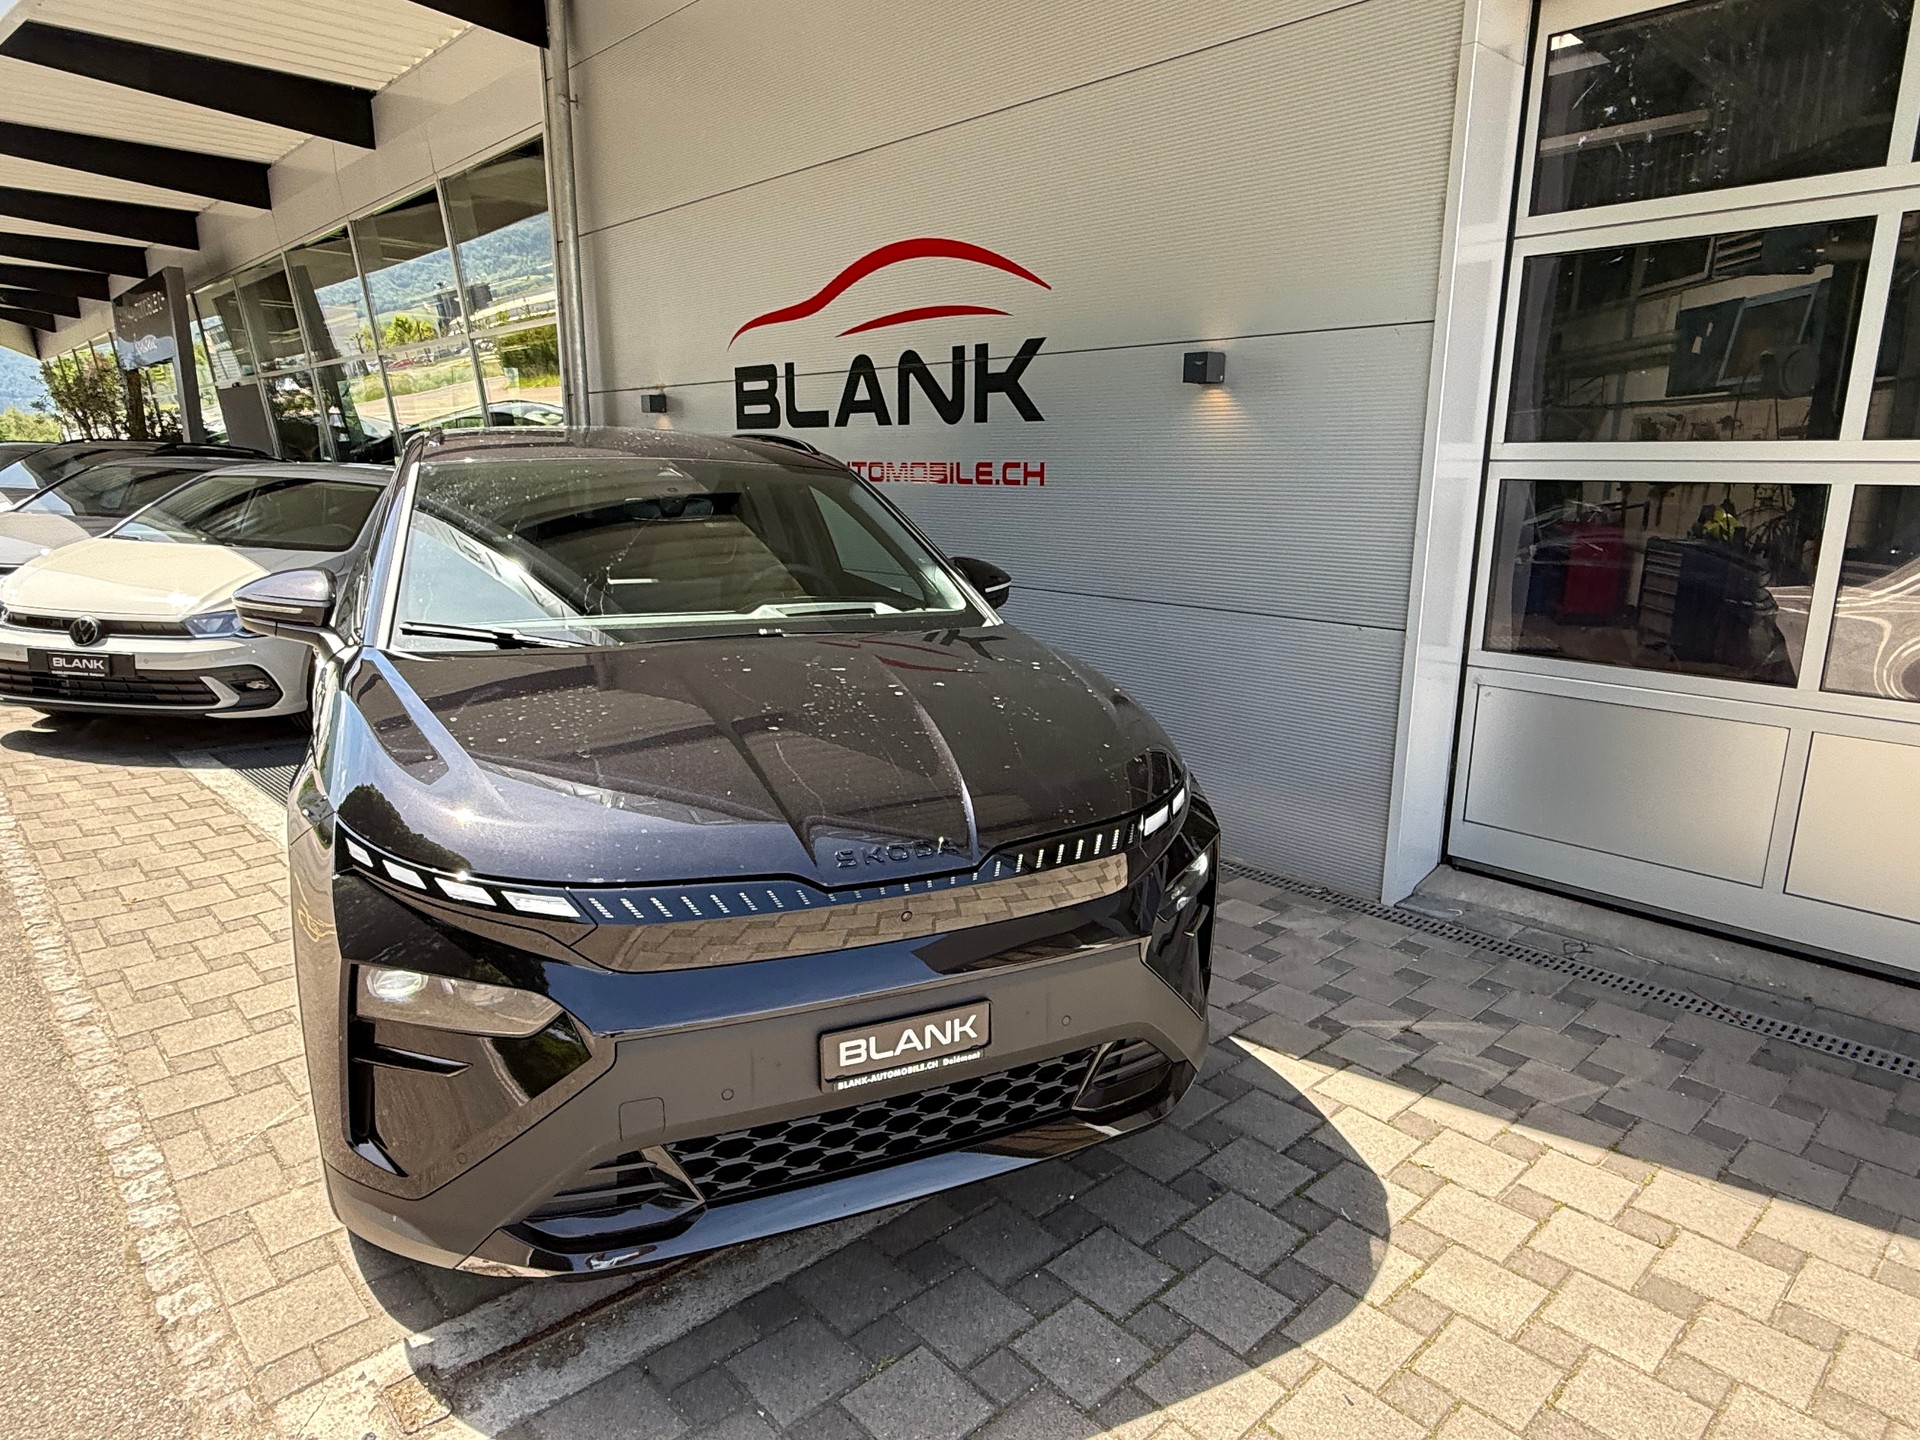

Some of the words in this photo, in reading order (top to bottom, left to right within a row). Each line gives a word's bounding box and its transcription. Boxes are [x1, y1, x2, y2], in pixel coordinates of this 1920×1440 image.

[735, 337, 1047, 430] BLANK
[52, 657, 105, 670] BLANK
[839, 1014, 978, 1067] BLANK
[837, 1060, 939, 1091] BLANK-AUTOMOBILE.CH
